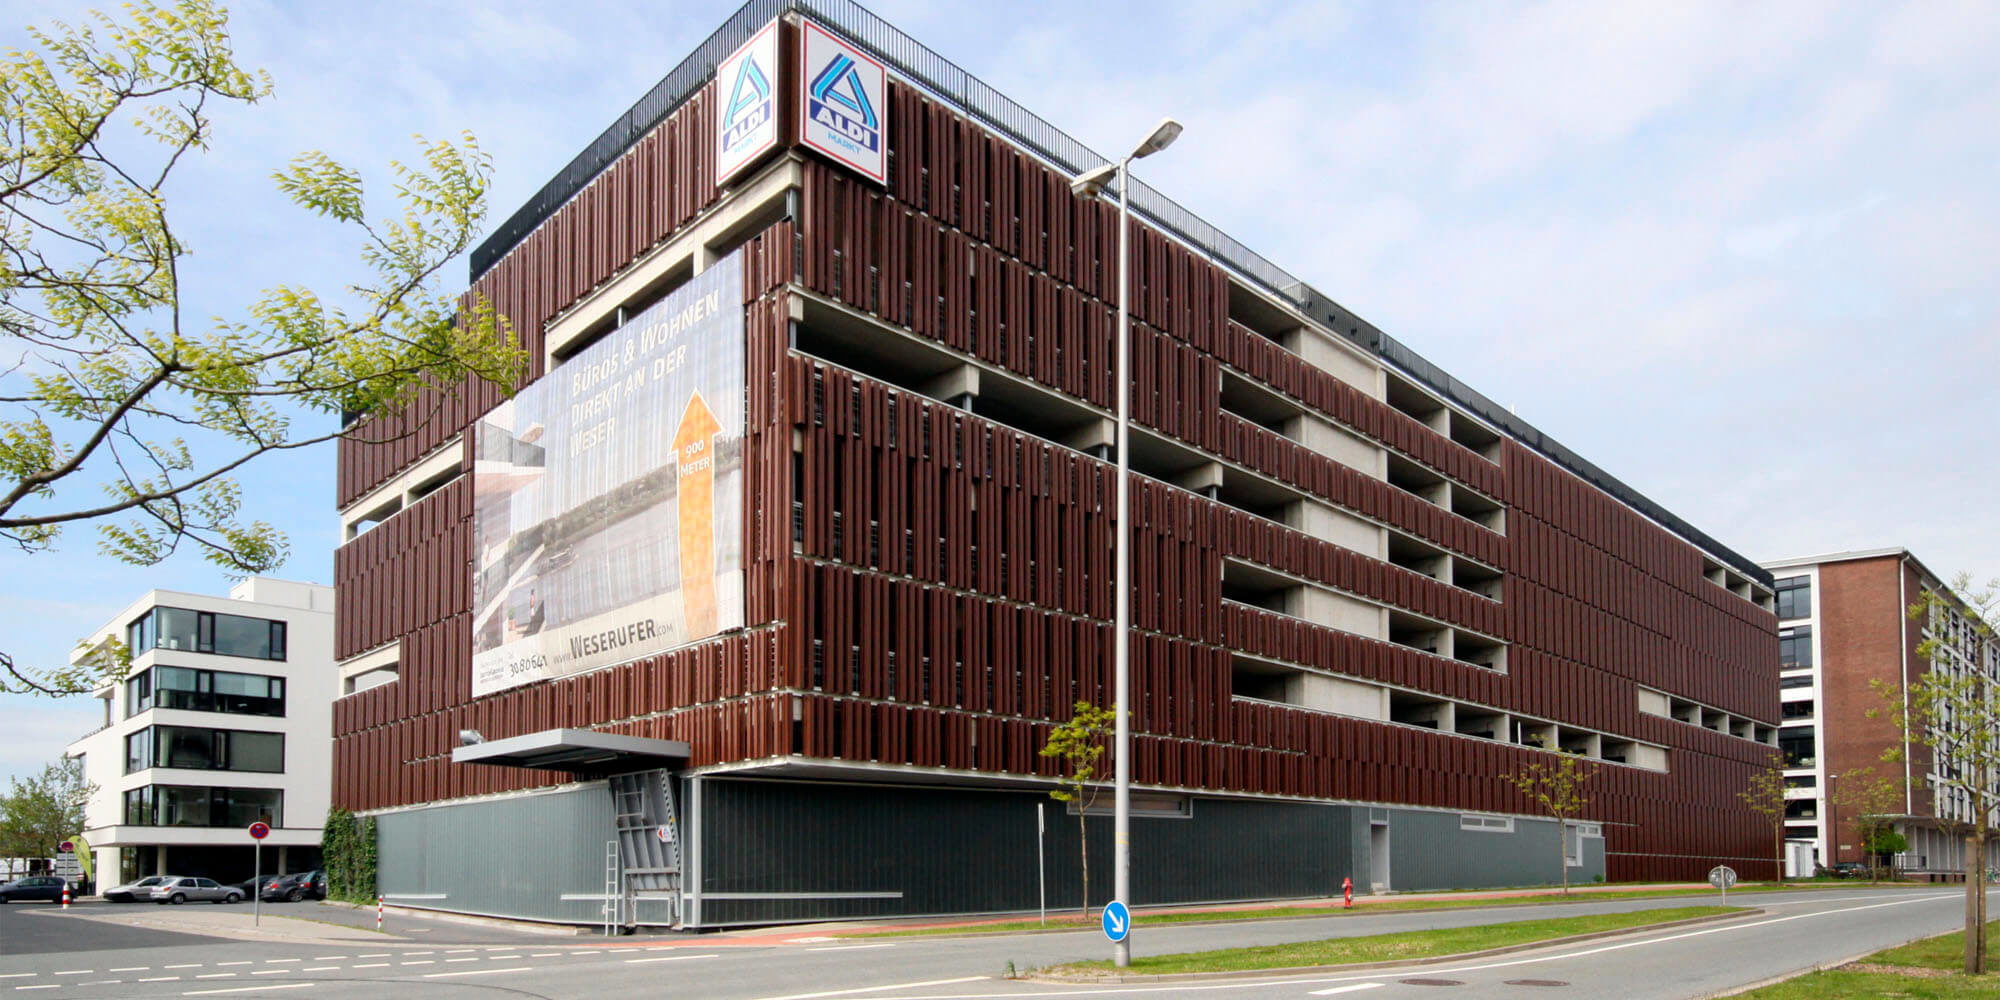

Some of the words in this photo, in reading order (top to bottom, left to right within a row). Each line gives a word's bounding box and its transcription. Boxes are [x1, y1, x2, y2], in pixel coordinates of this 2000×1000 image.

[726, 106, 765, 150] ALDI
[816, 107, 870, 148] ALDI
[828, 132, 861, 154] MARKT
[573, 353, 619, 397] BÜROS
[624, 339, 635, 366] &
[640, 288, 720, 355] WOHNEN
[571, 381, 621, 428] DIREKT
[624, 366, 646, 397] AN
[653, 344, 686, 381] DER
[570, 417, 616, 459] WESER
[686, 439, 704, 459] 900
[680, 456, 710, 478] METER
[510, 654, 548, 678] 3080641
